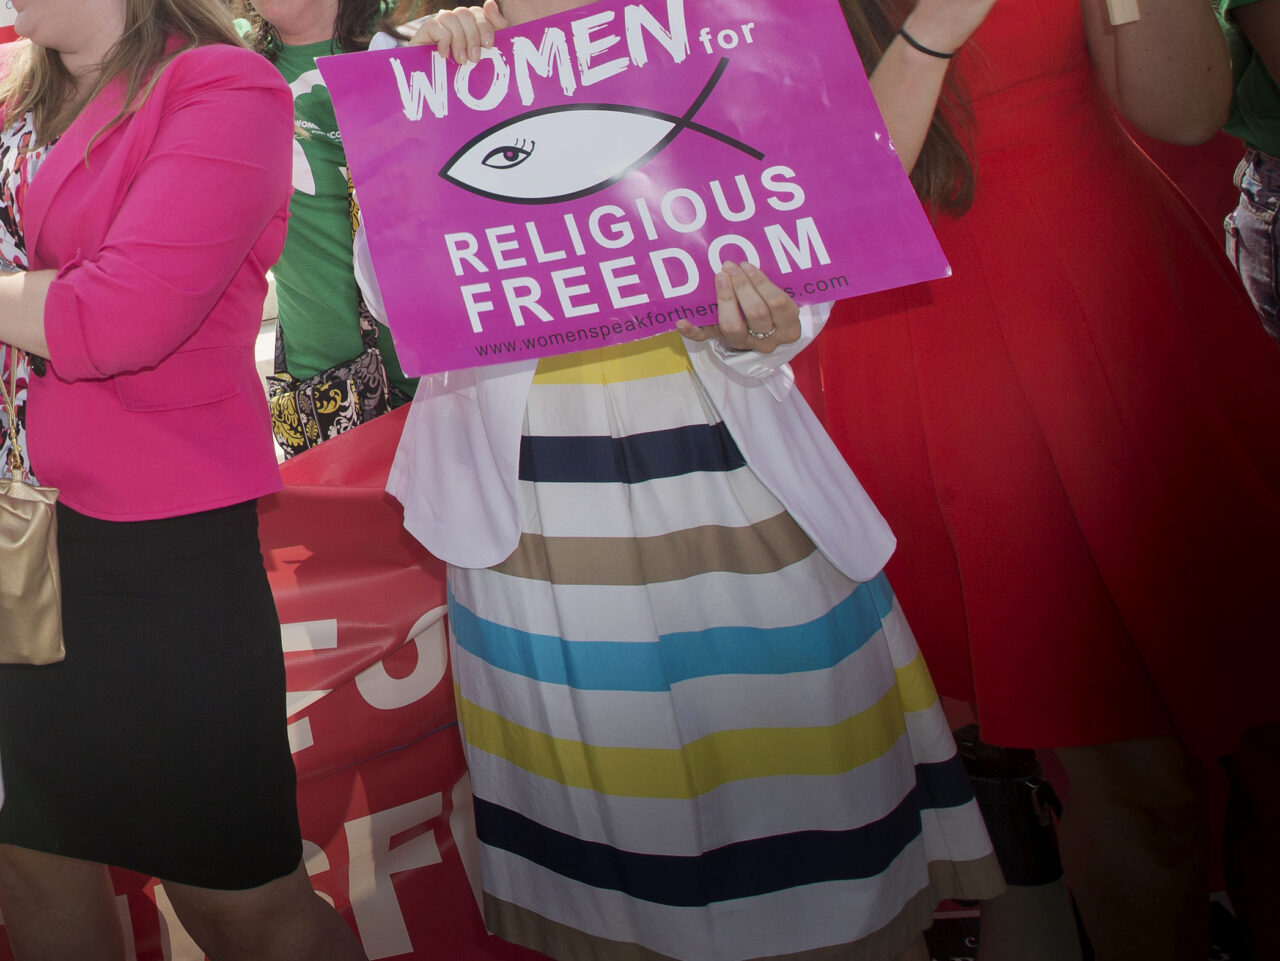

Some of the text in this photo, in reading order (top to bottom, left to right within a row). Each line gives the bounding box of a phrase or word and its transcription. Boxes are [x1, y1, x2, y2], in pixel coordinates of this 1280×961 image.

[698, 18, 757, 57] for
[444, 164, 806, 277] RELIGIOUS
[460, 215, 833, 335] FREEDOM
